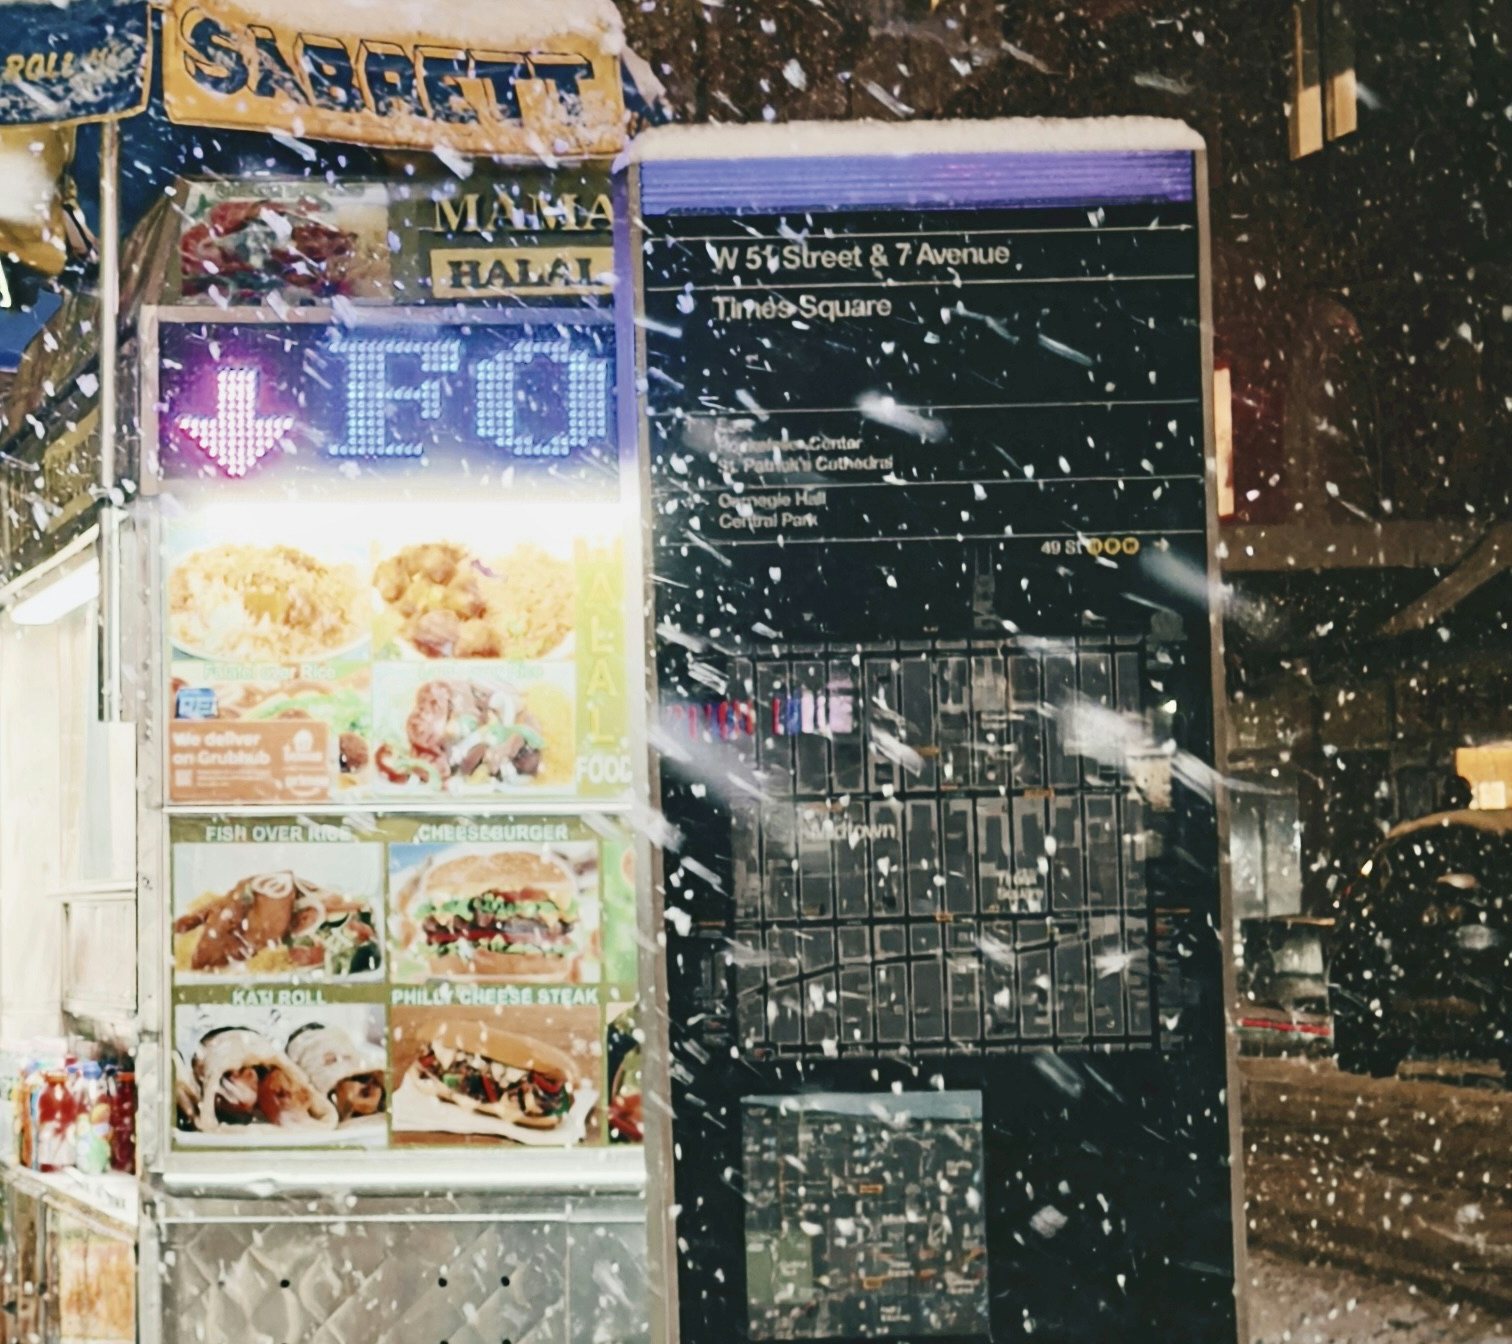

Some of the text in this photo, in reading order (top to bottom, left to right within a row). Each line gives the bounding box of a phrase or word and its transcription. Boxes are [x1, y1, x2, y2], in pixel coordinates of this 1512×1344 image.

[3, 52, 75, 81] ROLL
[180, 5, 594, 125] SABRETT
[434, 193, 614, 233] MAMA
[714, 242, 1011, 271] W 51 Street & 7 Avenue
[448, 258, 610, 289] HALAL
[712, 294, 893, 322] Times Square
[809, 435, 864, 451] Center
[795, 490, 827, 506] Hall
[719, 512, 818, 529] Central Park
[205, 824, 248, 841] FISH
[252, 824, 302, 841] OVER
[417, 823, 569, 841] CHEESEBURGER
[232, 988, 328, 1005] KATI ROLL
[391, 987, 599, 1005] PHILLY CHEESE STEAK
